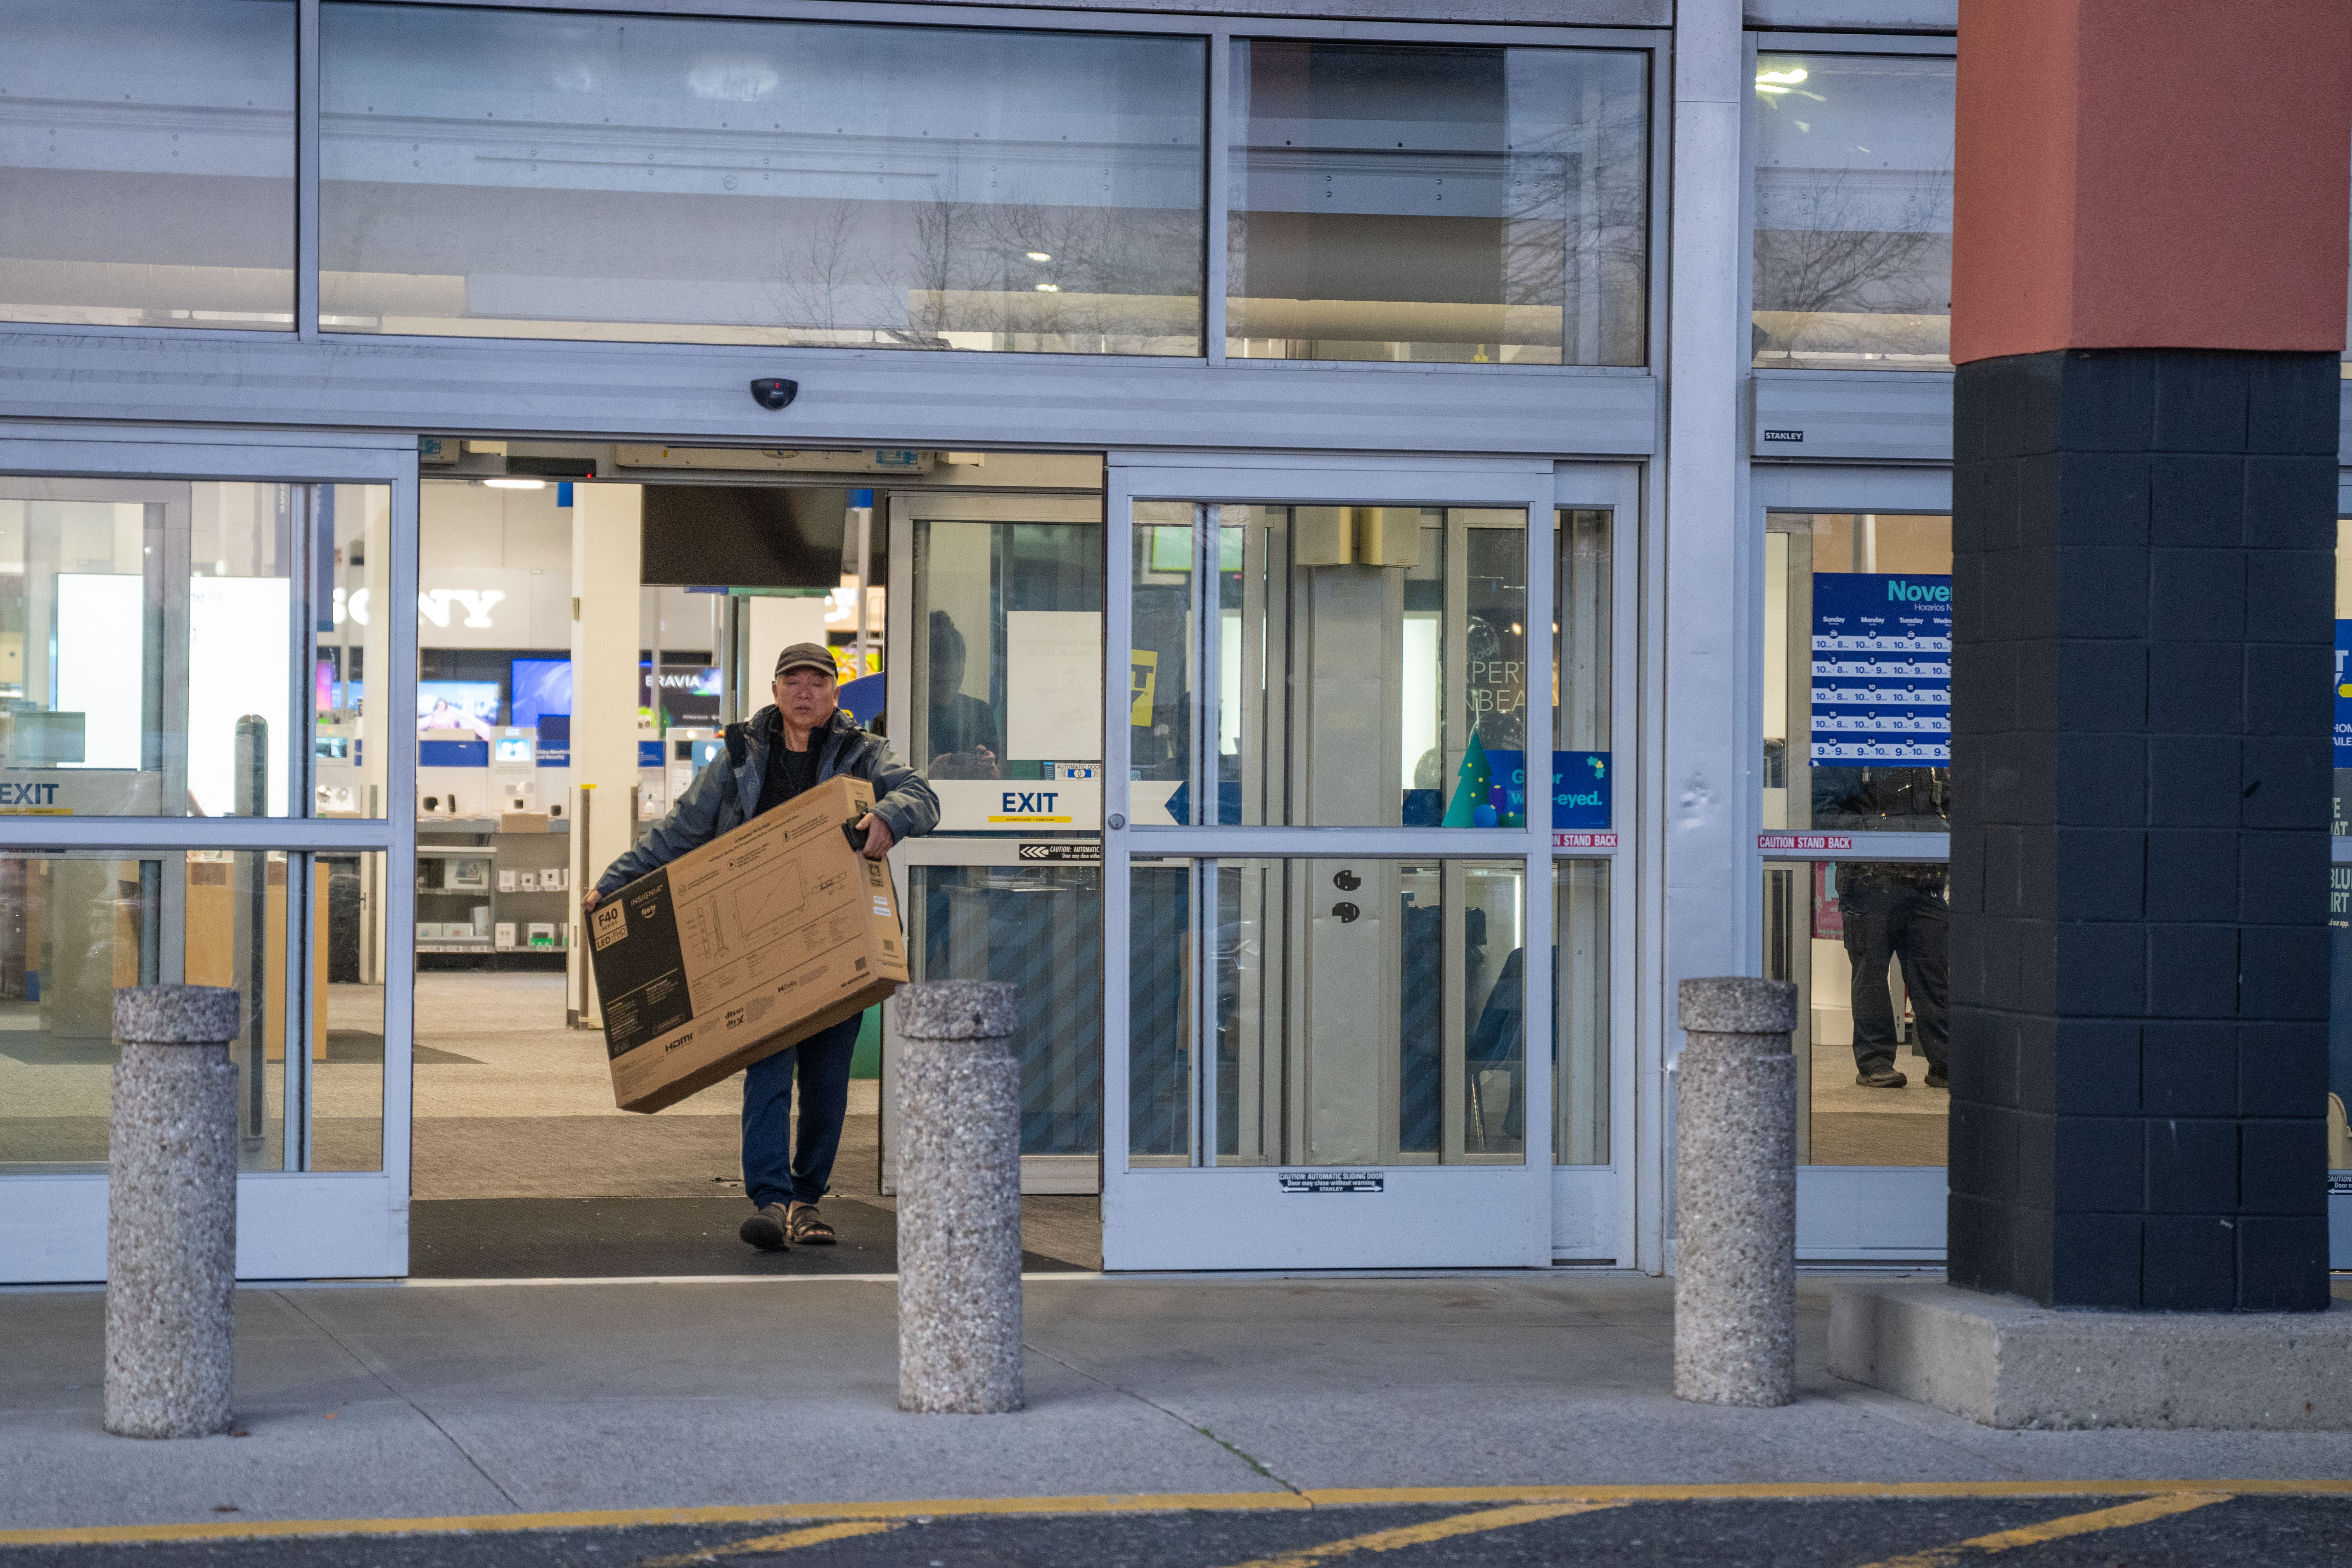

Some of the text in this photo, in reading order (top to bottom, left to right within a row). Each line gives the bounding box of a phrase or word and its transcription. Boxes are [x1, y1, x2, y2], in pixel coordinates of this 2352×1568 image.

[1888, 580, 1952, 602] Nove
[0, 783, 59, 804] EXIT
[1003, 792, 1058, 813] EXIT
[1564, 835, 1591, 846] STAND
[1594, 835, 1617, 846] BACK
[1759, 837, 1850, 848] CAUTION STAND BACK
[2331, 868, 2352, 890] BLU
[630, 886, 662, 906] INSIGNIA
[598, 908, 618, 927] F40
[597, 928, 626, 949] LED FHD
[665, 1033, 693, 1052] HDMI
